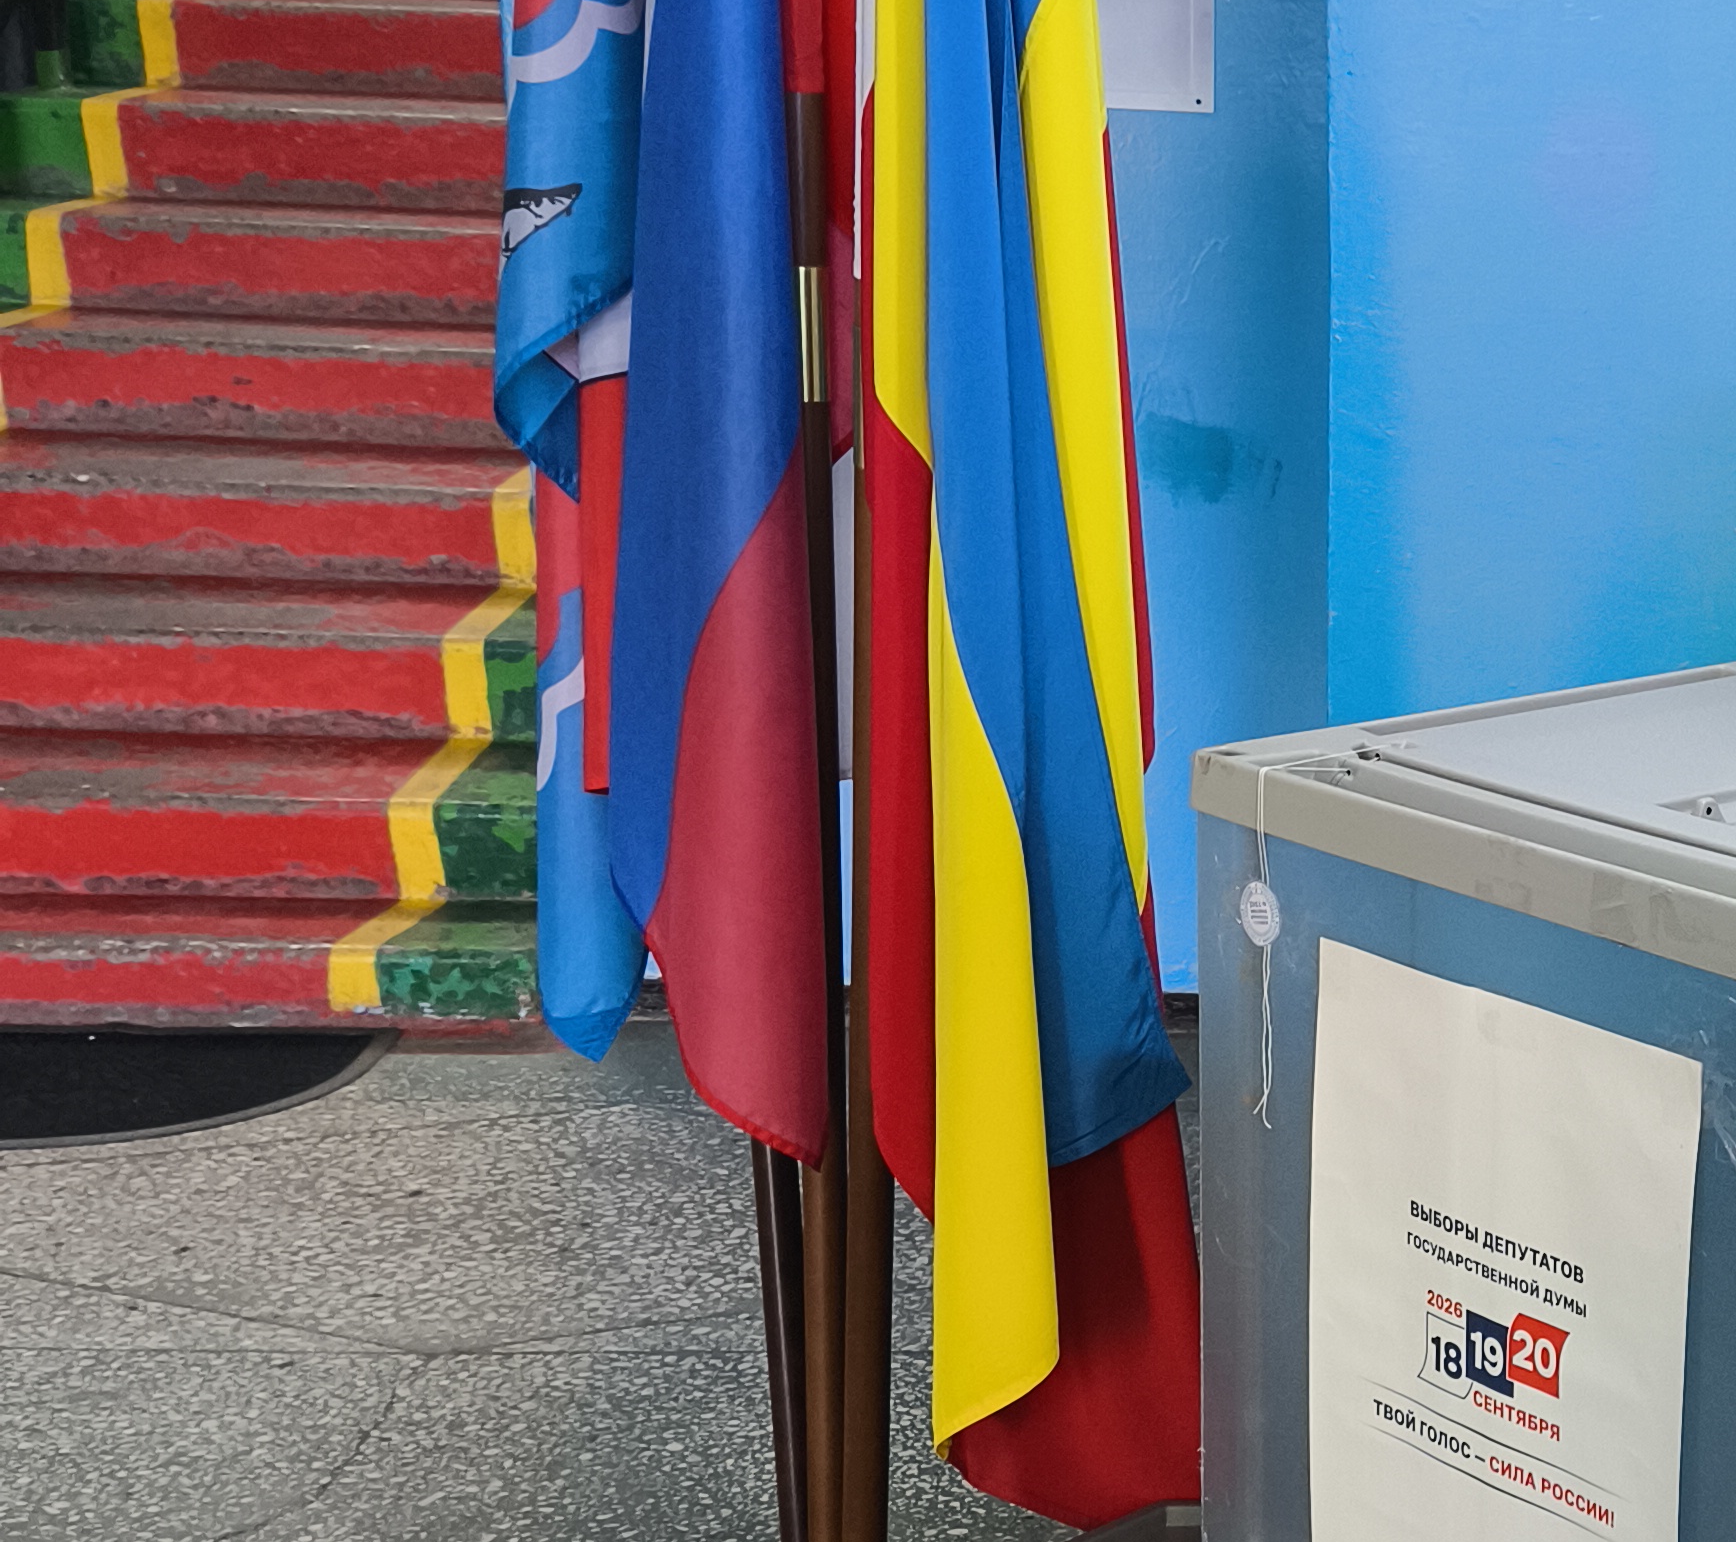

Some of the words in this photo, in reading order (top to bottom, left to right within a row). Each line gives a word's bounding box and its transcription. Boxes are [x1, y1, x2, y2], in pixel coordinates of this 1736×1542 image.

[1407, 1231, 1540, 1299] ГОСУДАРСТВЕННОЙ
[1543, 1288, 1587, 1318] ДУМЫ
[1410, 1199, 1479, 1243] ВЫБОРЫ
[1482, 1231, 1584, 1284] ДЕПУТАТОВ
[1427, 1289, 1463, 1318] 2026
[1431, 1335, 1463, 1380] 18
[1470, 1331, 1504, 1377] 19
[1511, 1329, 1557, 1379] 20
[1473, 1390, 1561, 1442] СЕНТЯБРЯ
[1373, 1398, 1416, 1432] ТВОЙ
[1420, 1420, 1471, 1459] ГОЛОС
[1489, 1456, 1536, 1490] СИЛА
[1541, 1477, 1615, 1528] РОССИИ!
